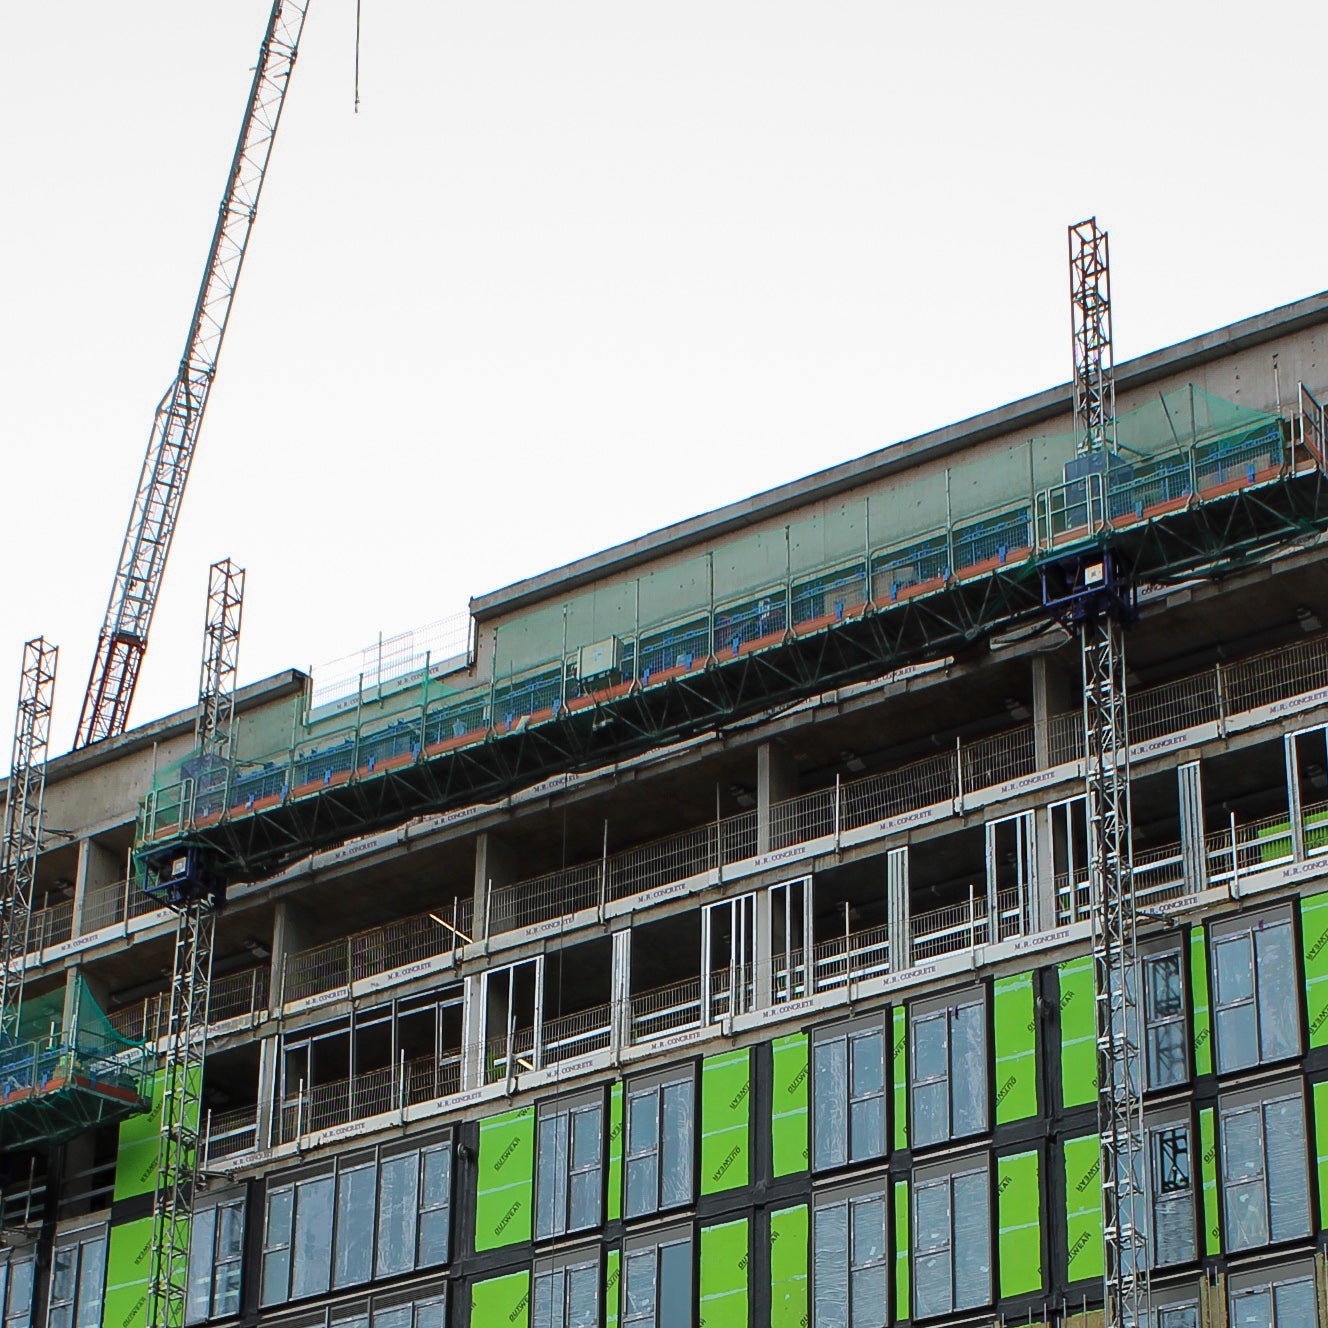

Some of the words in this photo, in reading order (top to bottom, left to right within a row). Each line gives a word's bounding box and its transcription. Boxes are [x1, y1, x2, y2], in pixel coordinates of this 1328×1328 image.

[1288, 691, 1328, 709] CONCRETE
[1149, 735, 1187, 751] CONCRETE
[1018, 771, 1055, 788] CONCRETE
[896, 810, 932, 826] CONCRETE
[771, 847, 806, 862] CONCRETE
[653, 883, 685, 898] CONCRETE
[1158, 897, 1197, 913] CONCRETE
[1031, 930, 1069, 945] CONCRETE
[900, 966, 936, 982] CONCRETE
[779, 1000, 814, 1015] CONCRETE
[667, 1031, 701, 1046] CONCRETE
[494, 1138, 521, 1172] OUTWEAR
[712, 1146, 742, 1182] OUTWEAR
[494, 1202, 522, 1236] OUTWEAR
